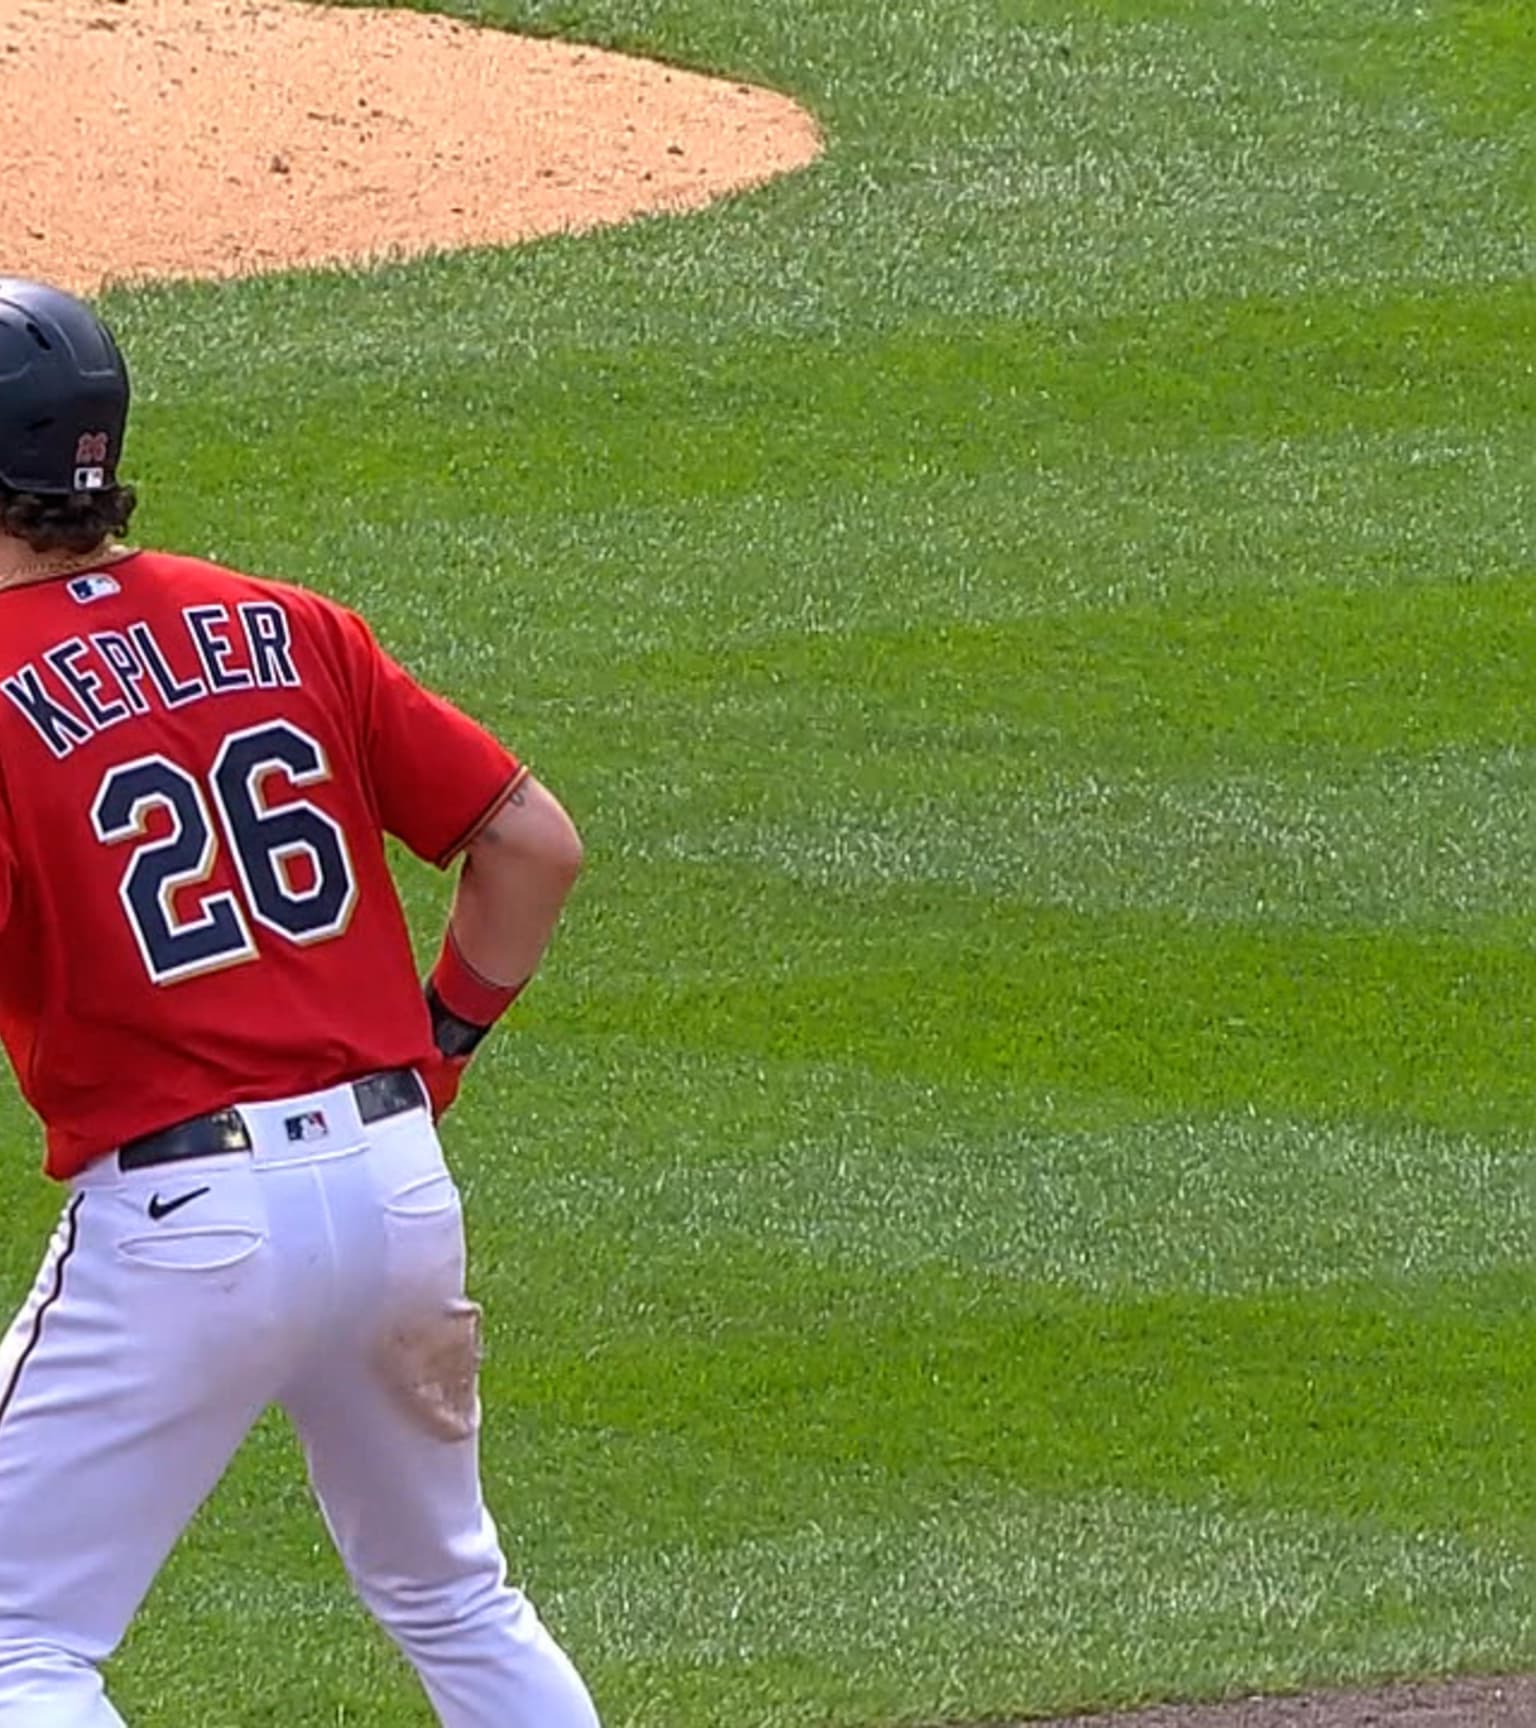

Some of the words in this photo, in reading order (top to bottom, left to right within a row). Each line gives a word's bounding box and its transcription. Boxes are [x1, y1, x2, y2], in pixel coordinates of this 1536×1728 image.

[76, 431, 108, 463] 26
[0, 601, 301, 758] KEPLER
[91, 719, 358, 985] 26
